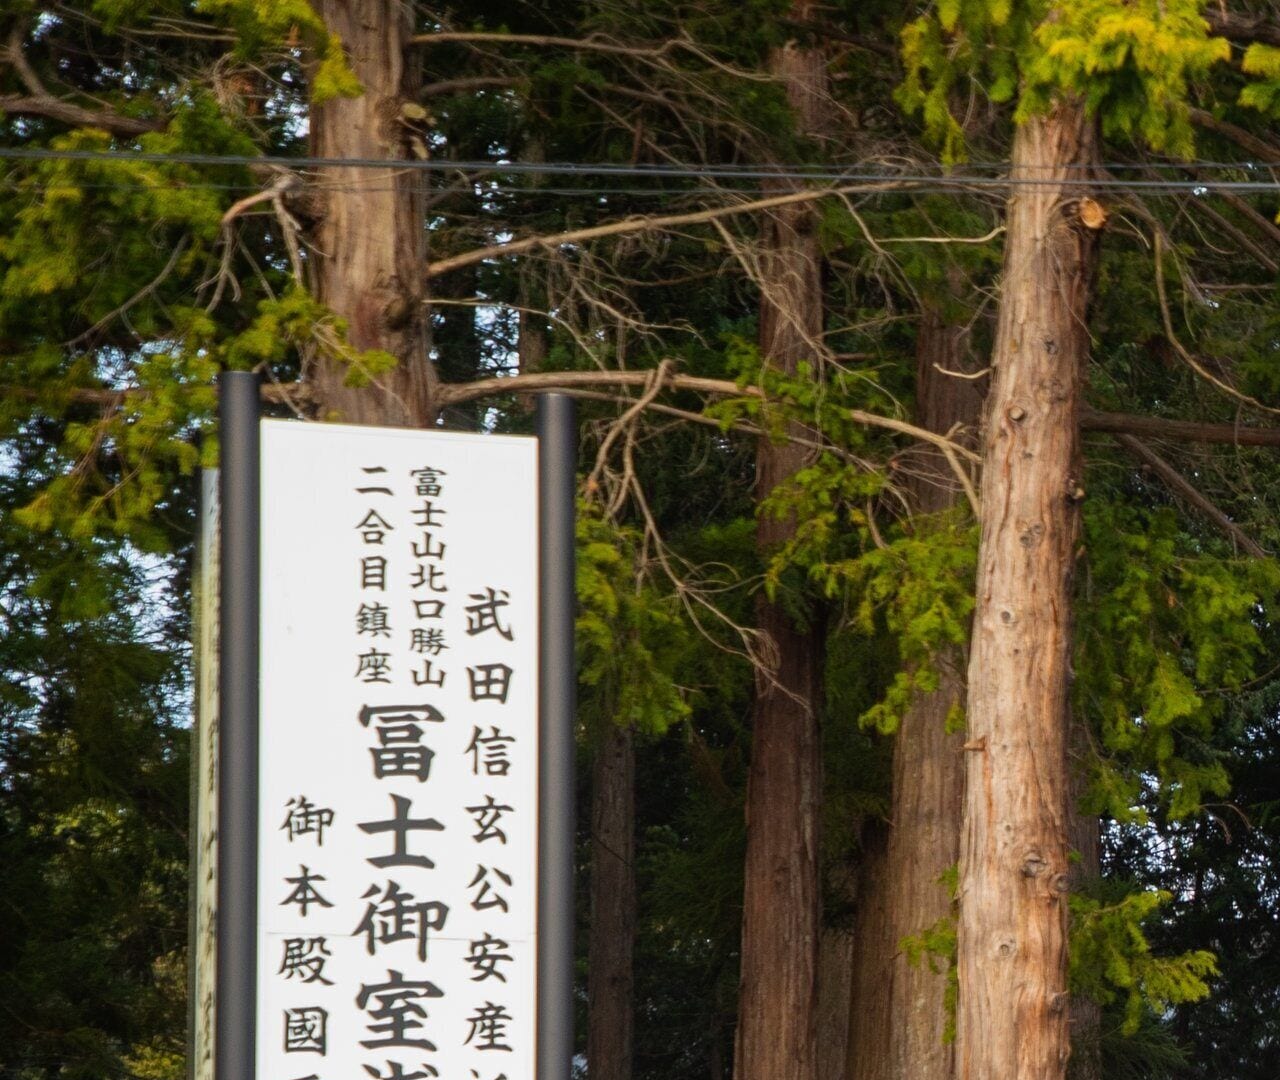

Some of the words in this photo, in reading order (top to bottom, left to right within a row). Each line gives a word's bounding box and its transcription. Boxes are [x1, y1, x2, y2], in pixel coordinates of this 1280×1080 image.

[353, 465, 395, 685] 二合目鎮座
[408, 465, 451, 689] 富士山北口勝山
